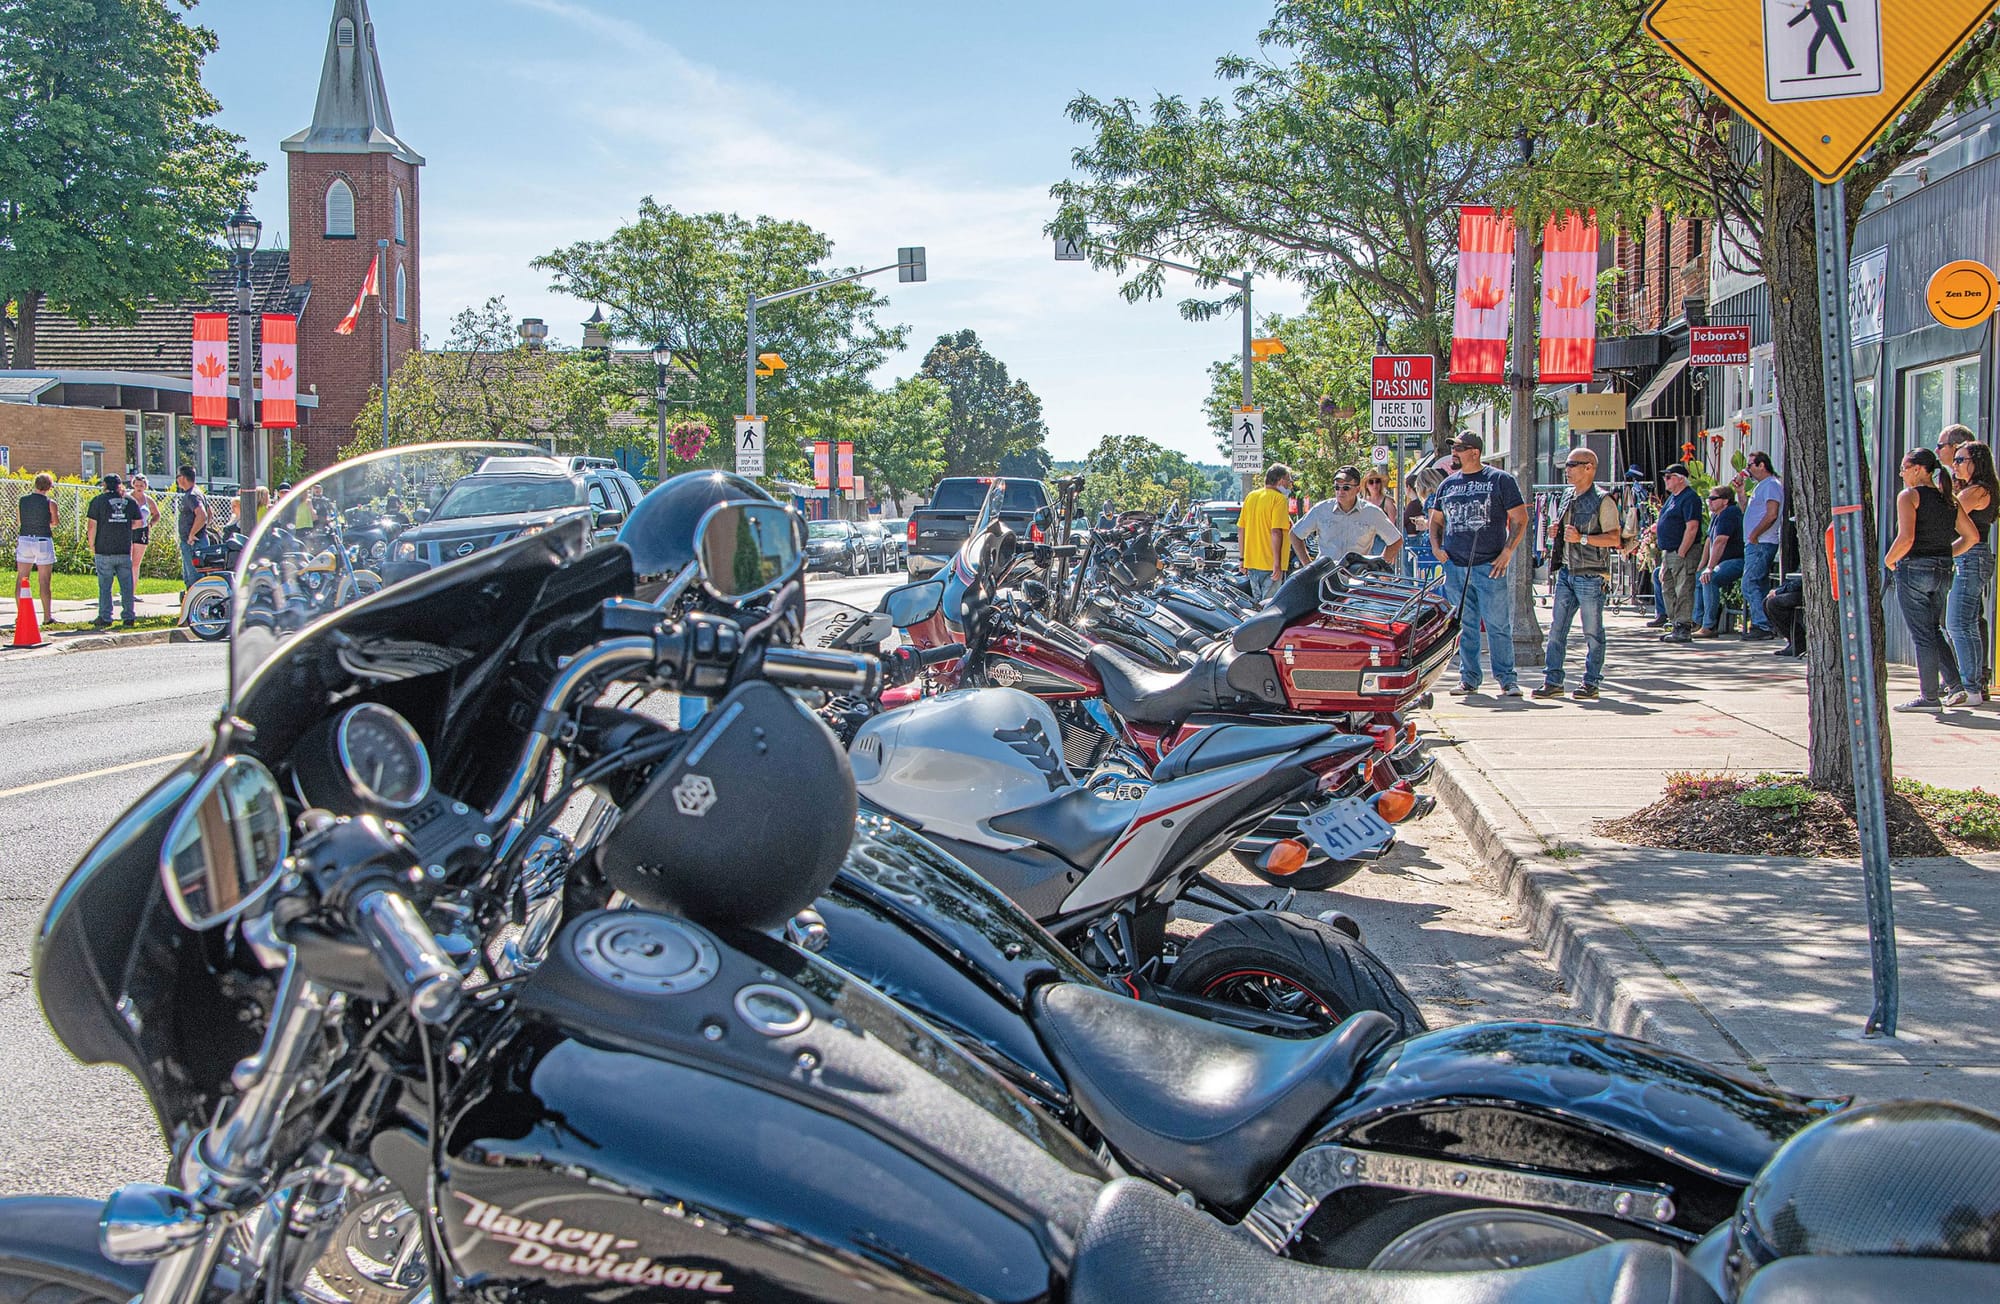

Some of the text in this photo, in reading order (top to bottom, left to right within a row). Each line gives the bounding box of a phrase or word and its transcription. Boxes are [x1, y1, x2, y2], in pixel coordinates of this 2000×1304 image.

[1693, 330, 1746, 341] Debora's
[1691, 353, 1747, 363] CHOCOLATES
[1394, 360, 1411, 378] NO
[1376, 379, 1429, 396] PASSING
[1381, 402, 1423, 414] HERE TO
[1378, 416, 1426, 427] CROSSING
[1466, 481, 1493, 496] York
[490, 1232, 734, 1294] Davidson
